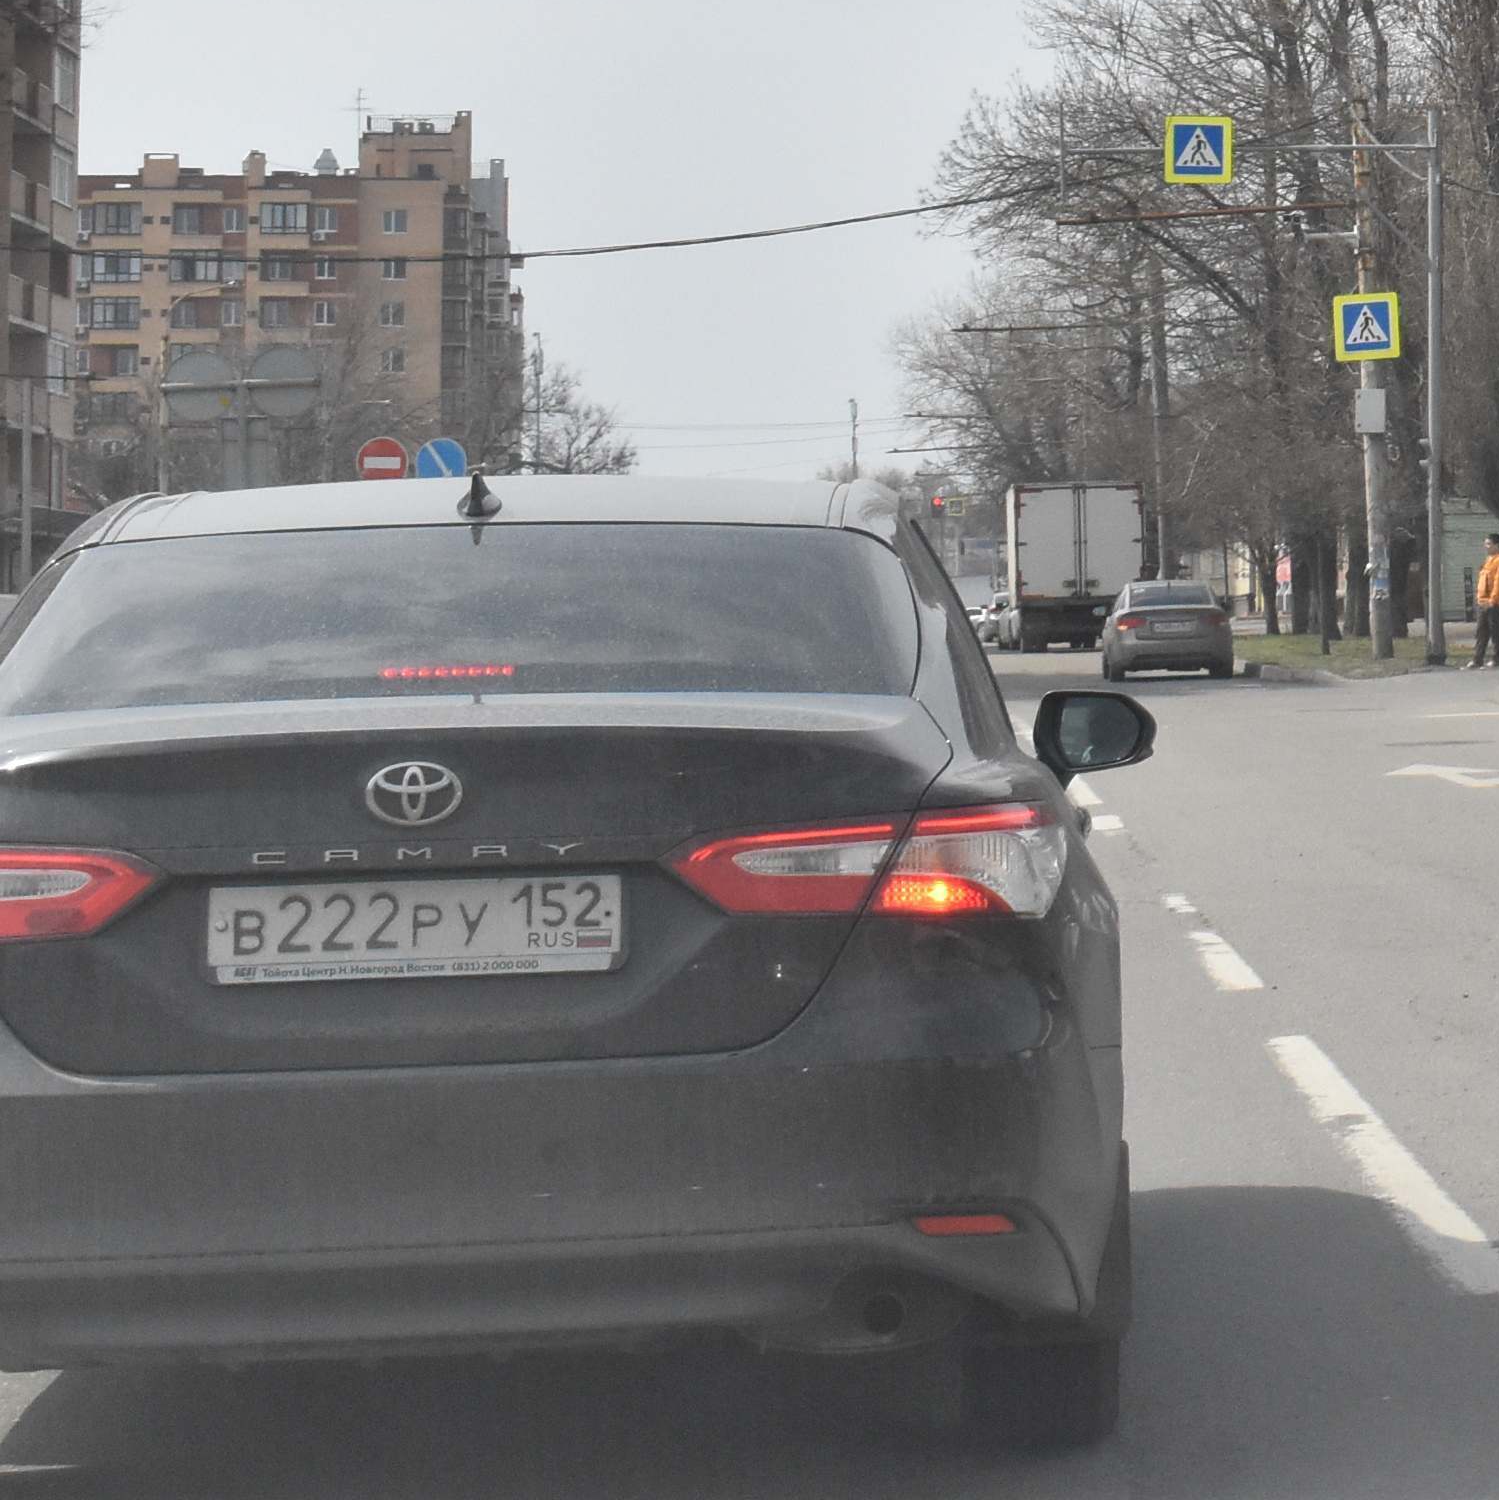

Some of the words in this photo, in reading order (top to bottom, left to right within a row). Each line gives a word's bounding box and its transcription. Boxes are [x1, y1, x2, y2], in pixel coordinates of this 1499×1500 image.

[252, 842, 583, 865] CAMRY
[232, 891, 489, 956] В222РУ
[526, 931, 575, 949] RUS
[301, 967, 337, 982] Центр
[406, 963, 447, 974] Восток
